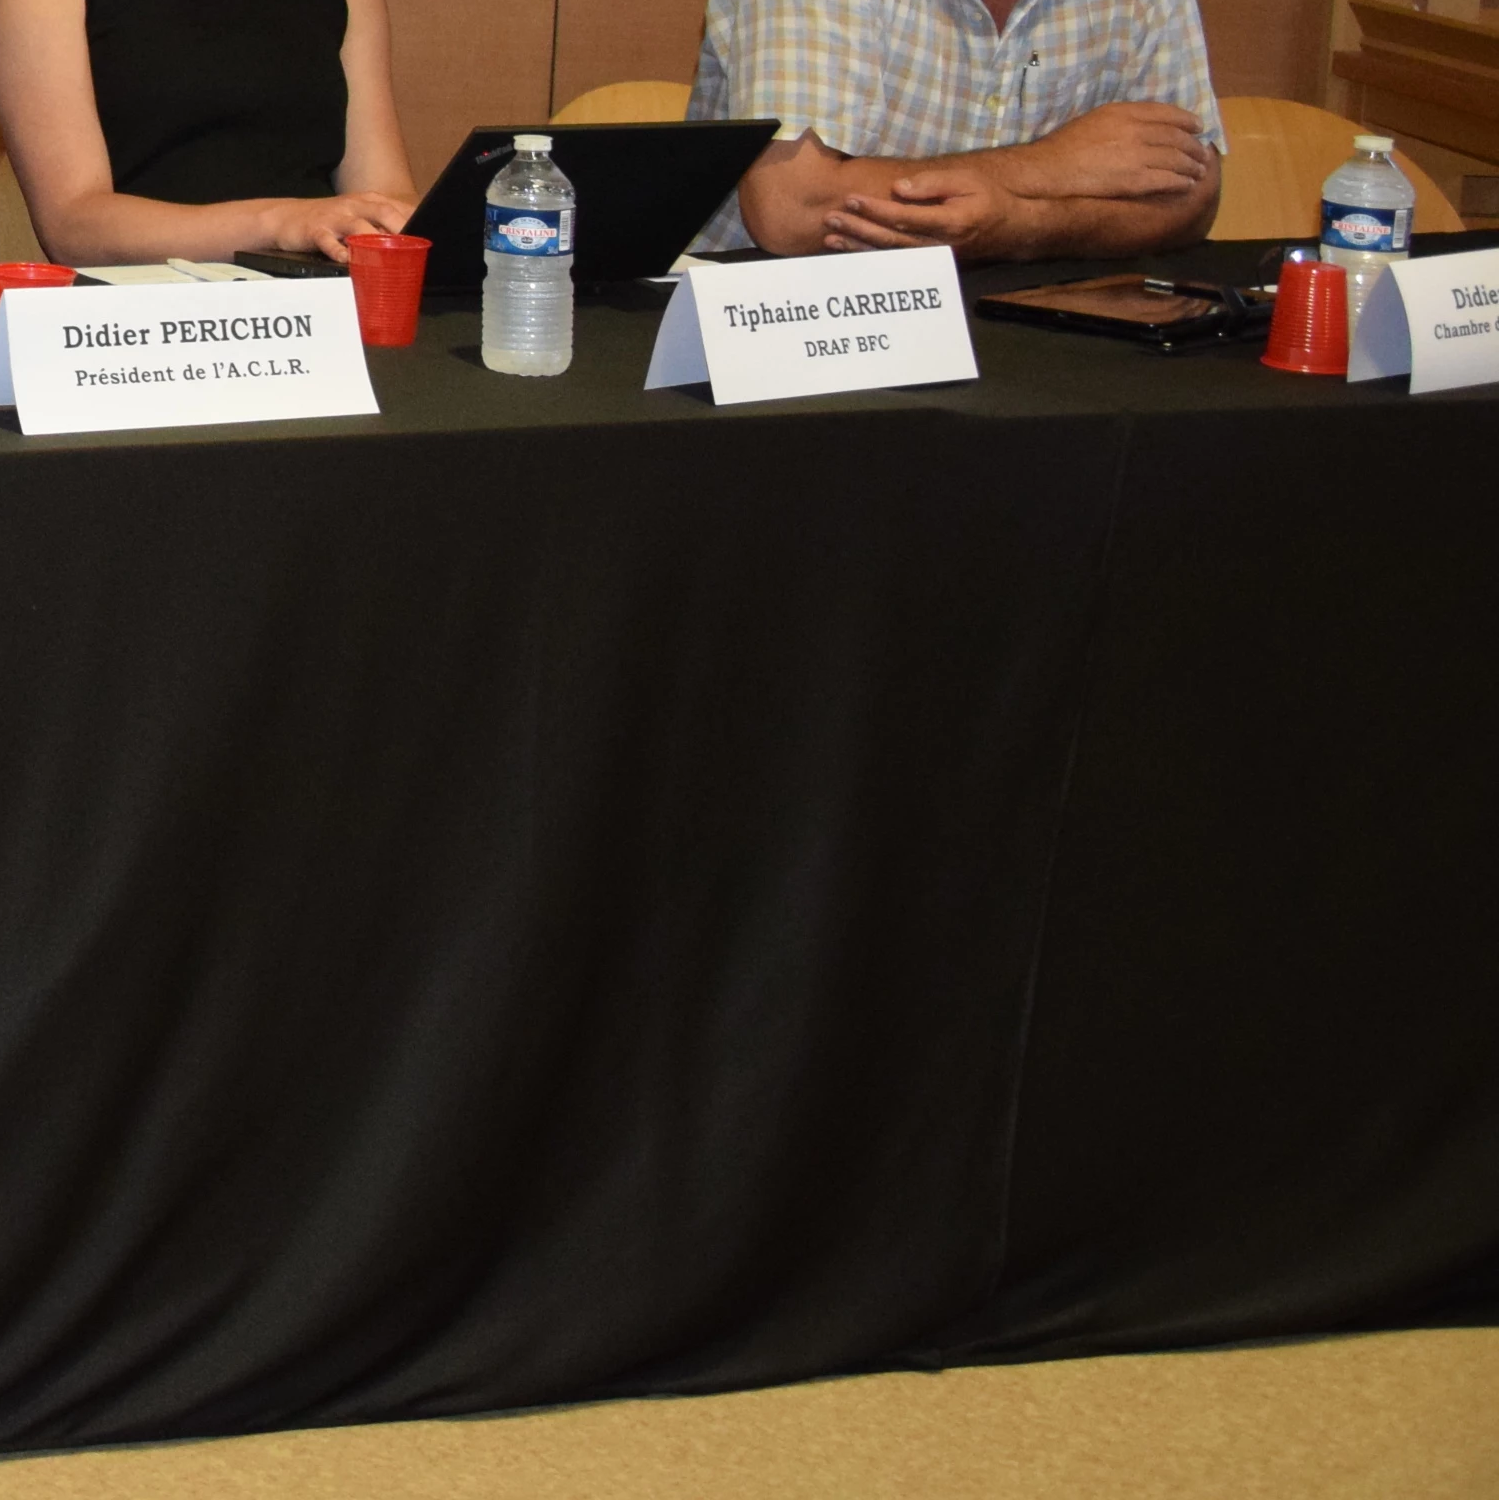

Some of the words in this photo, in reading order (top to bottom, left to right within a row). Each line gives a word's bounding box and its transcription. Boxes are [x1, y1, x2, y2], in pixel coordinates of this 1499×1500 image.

[499, 225, 556, 238] CRISTALINE
[1333, 221, 1389, 235] CRISTALINE
[1451, 284, 1499, 309] Didie
[724, 300, 820, 332] Tiphaine
[826, 287, 942, 318] CARRIERE
[63, 323, 150, 349] Didier
[160, 315, 312, 344] PERICHON
[1434, 319, 1490, 340] Chambre
[804, 338, 851, 357] DRAF
[856, 334, 890, 353] BFC
[75, 366, 175, 387] Président
[183, 364, 206, 381] de
[213, 358, 310, 379] l'A.C.L.R.
